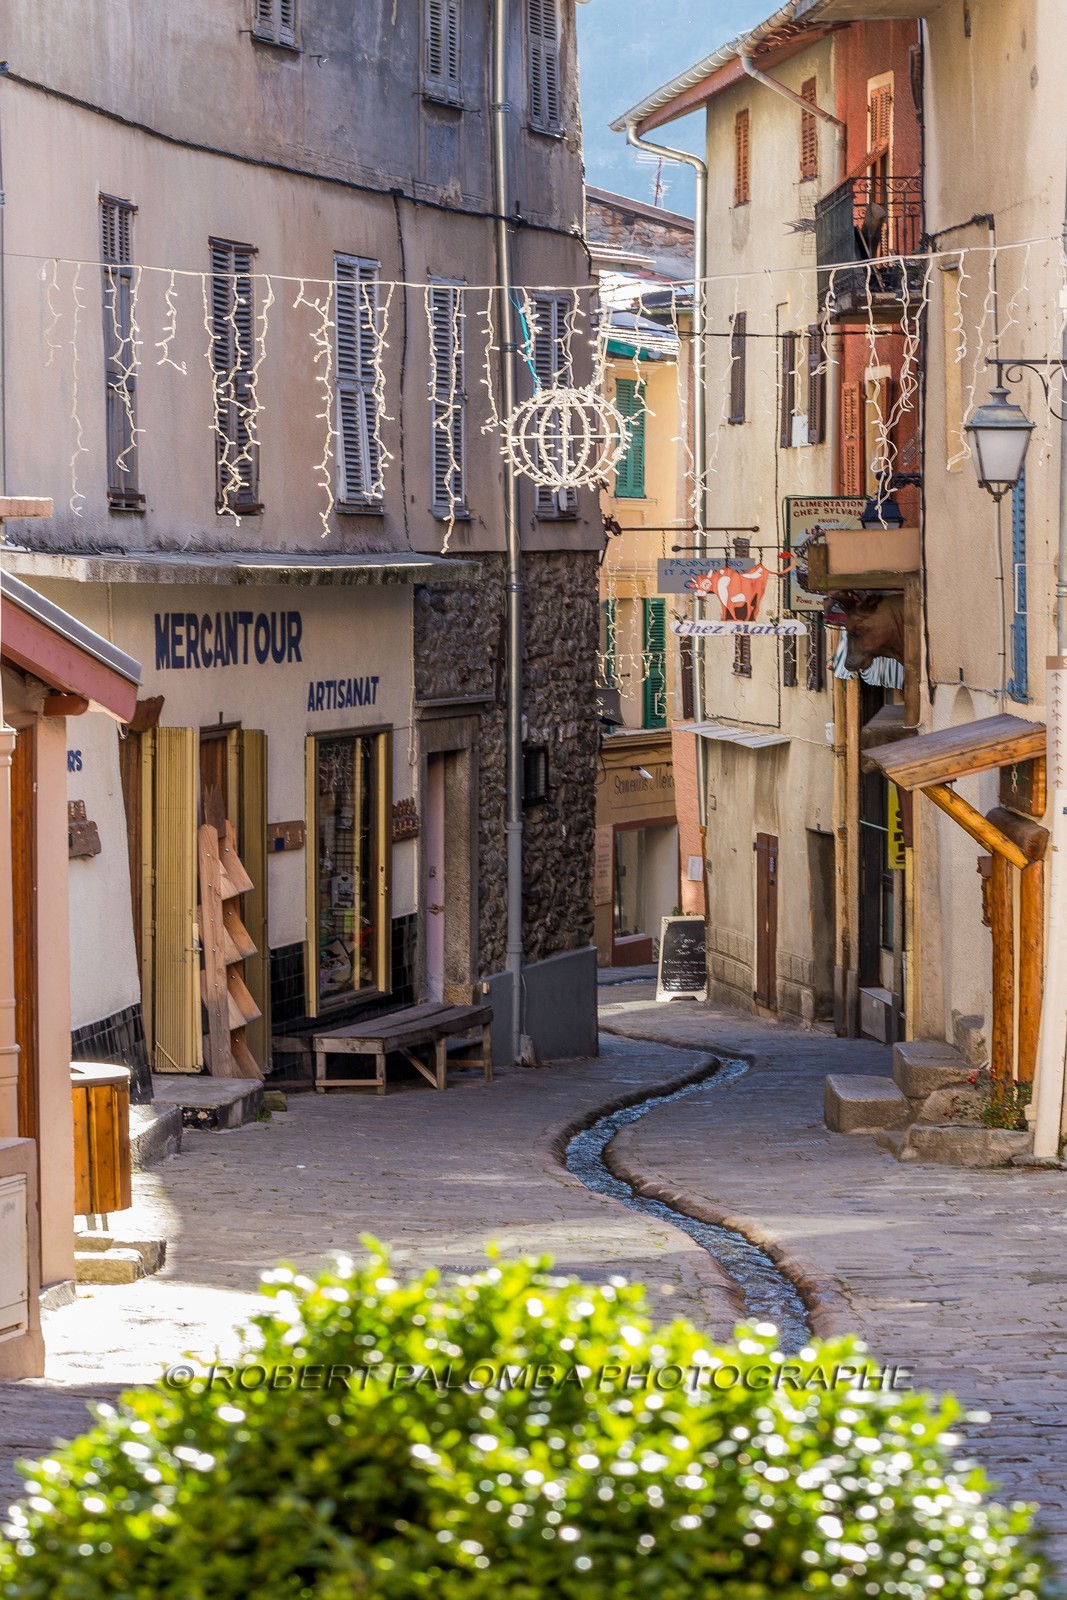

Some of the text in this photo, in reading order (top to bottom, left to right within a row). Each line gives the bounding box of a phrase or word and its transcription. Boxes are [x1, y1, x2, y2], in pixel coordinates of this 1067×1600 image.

[793, 507, 864, 518] CHEZ SYLVAIN
[674, 622, 798, 635] Chez Marco
[154, 611, 303, 671] MERCANTOUR
[307, 676, 380, 712] ARTISANAT
